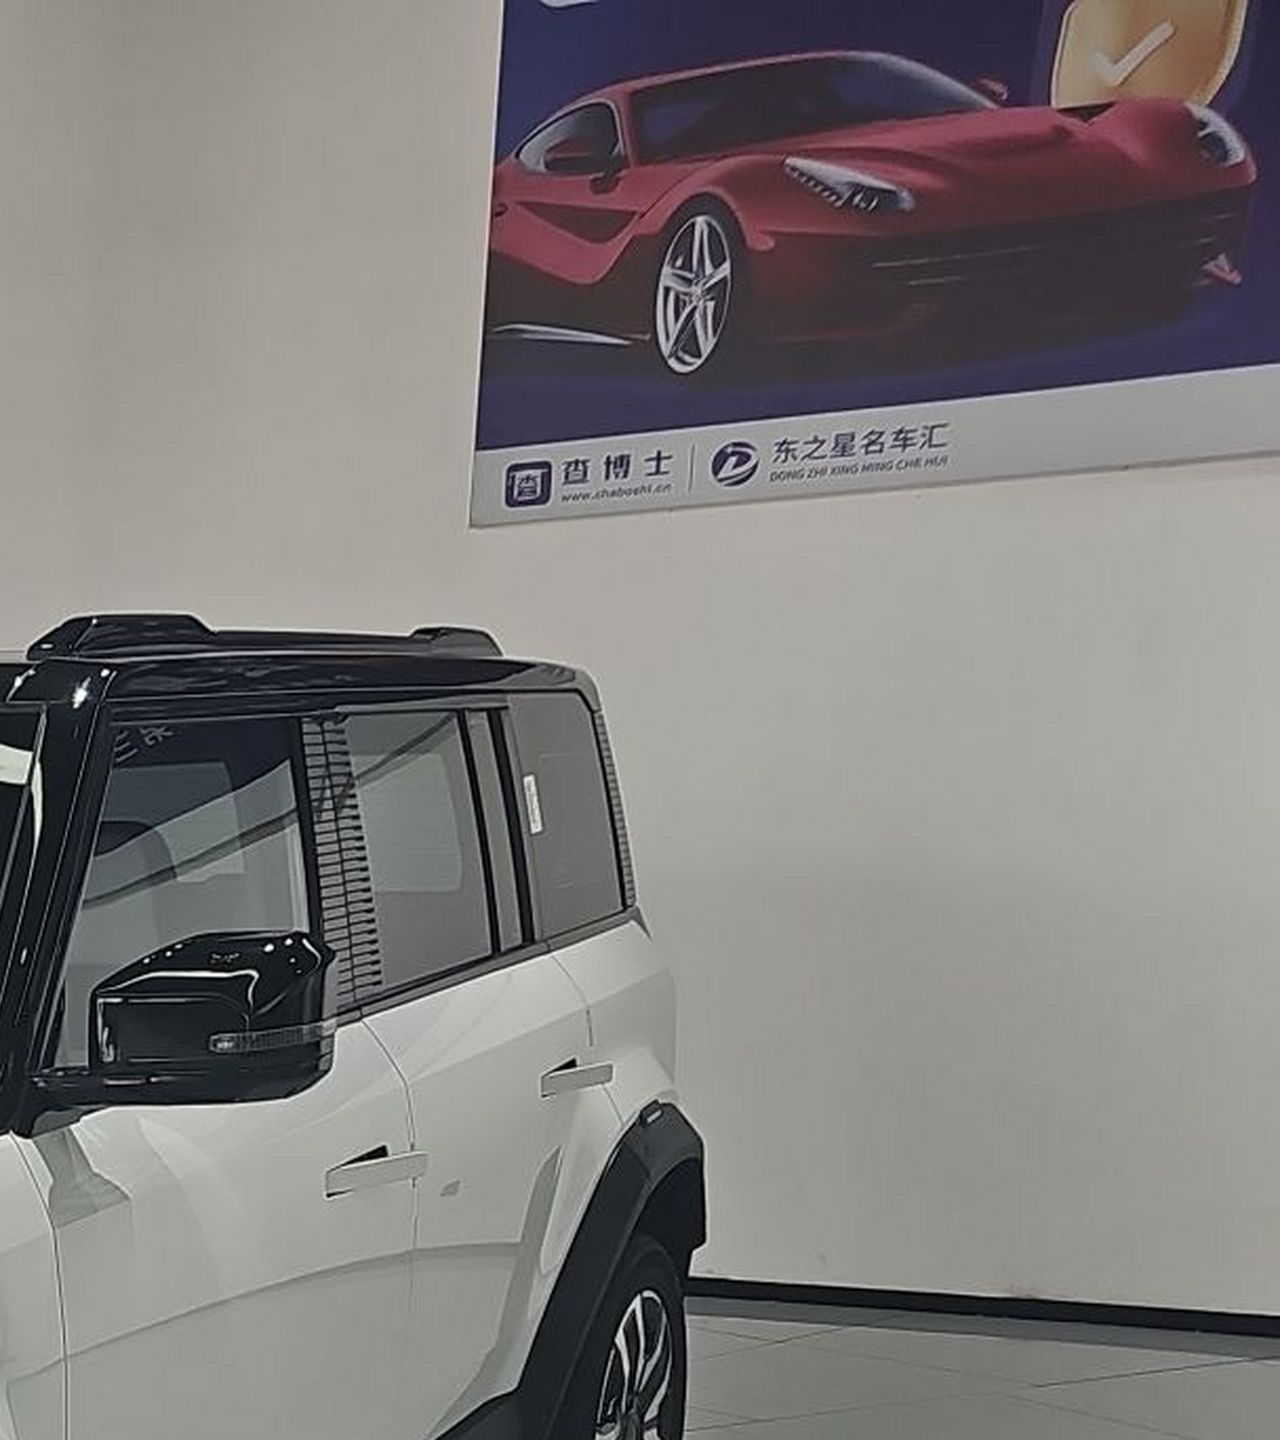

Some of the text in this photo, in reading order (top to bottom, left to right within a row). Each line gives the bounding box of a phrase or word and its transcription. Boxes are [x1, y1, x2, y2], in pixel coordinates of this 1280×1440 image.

[772, 422, 950, 464] 东之星名车汇
[769, 468, 805, 482] DONG
